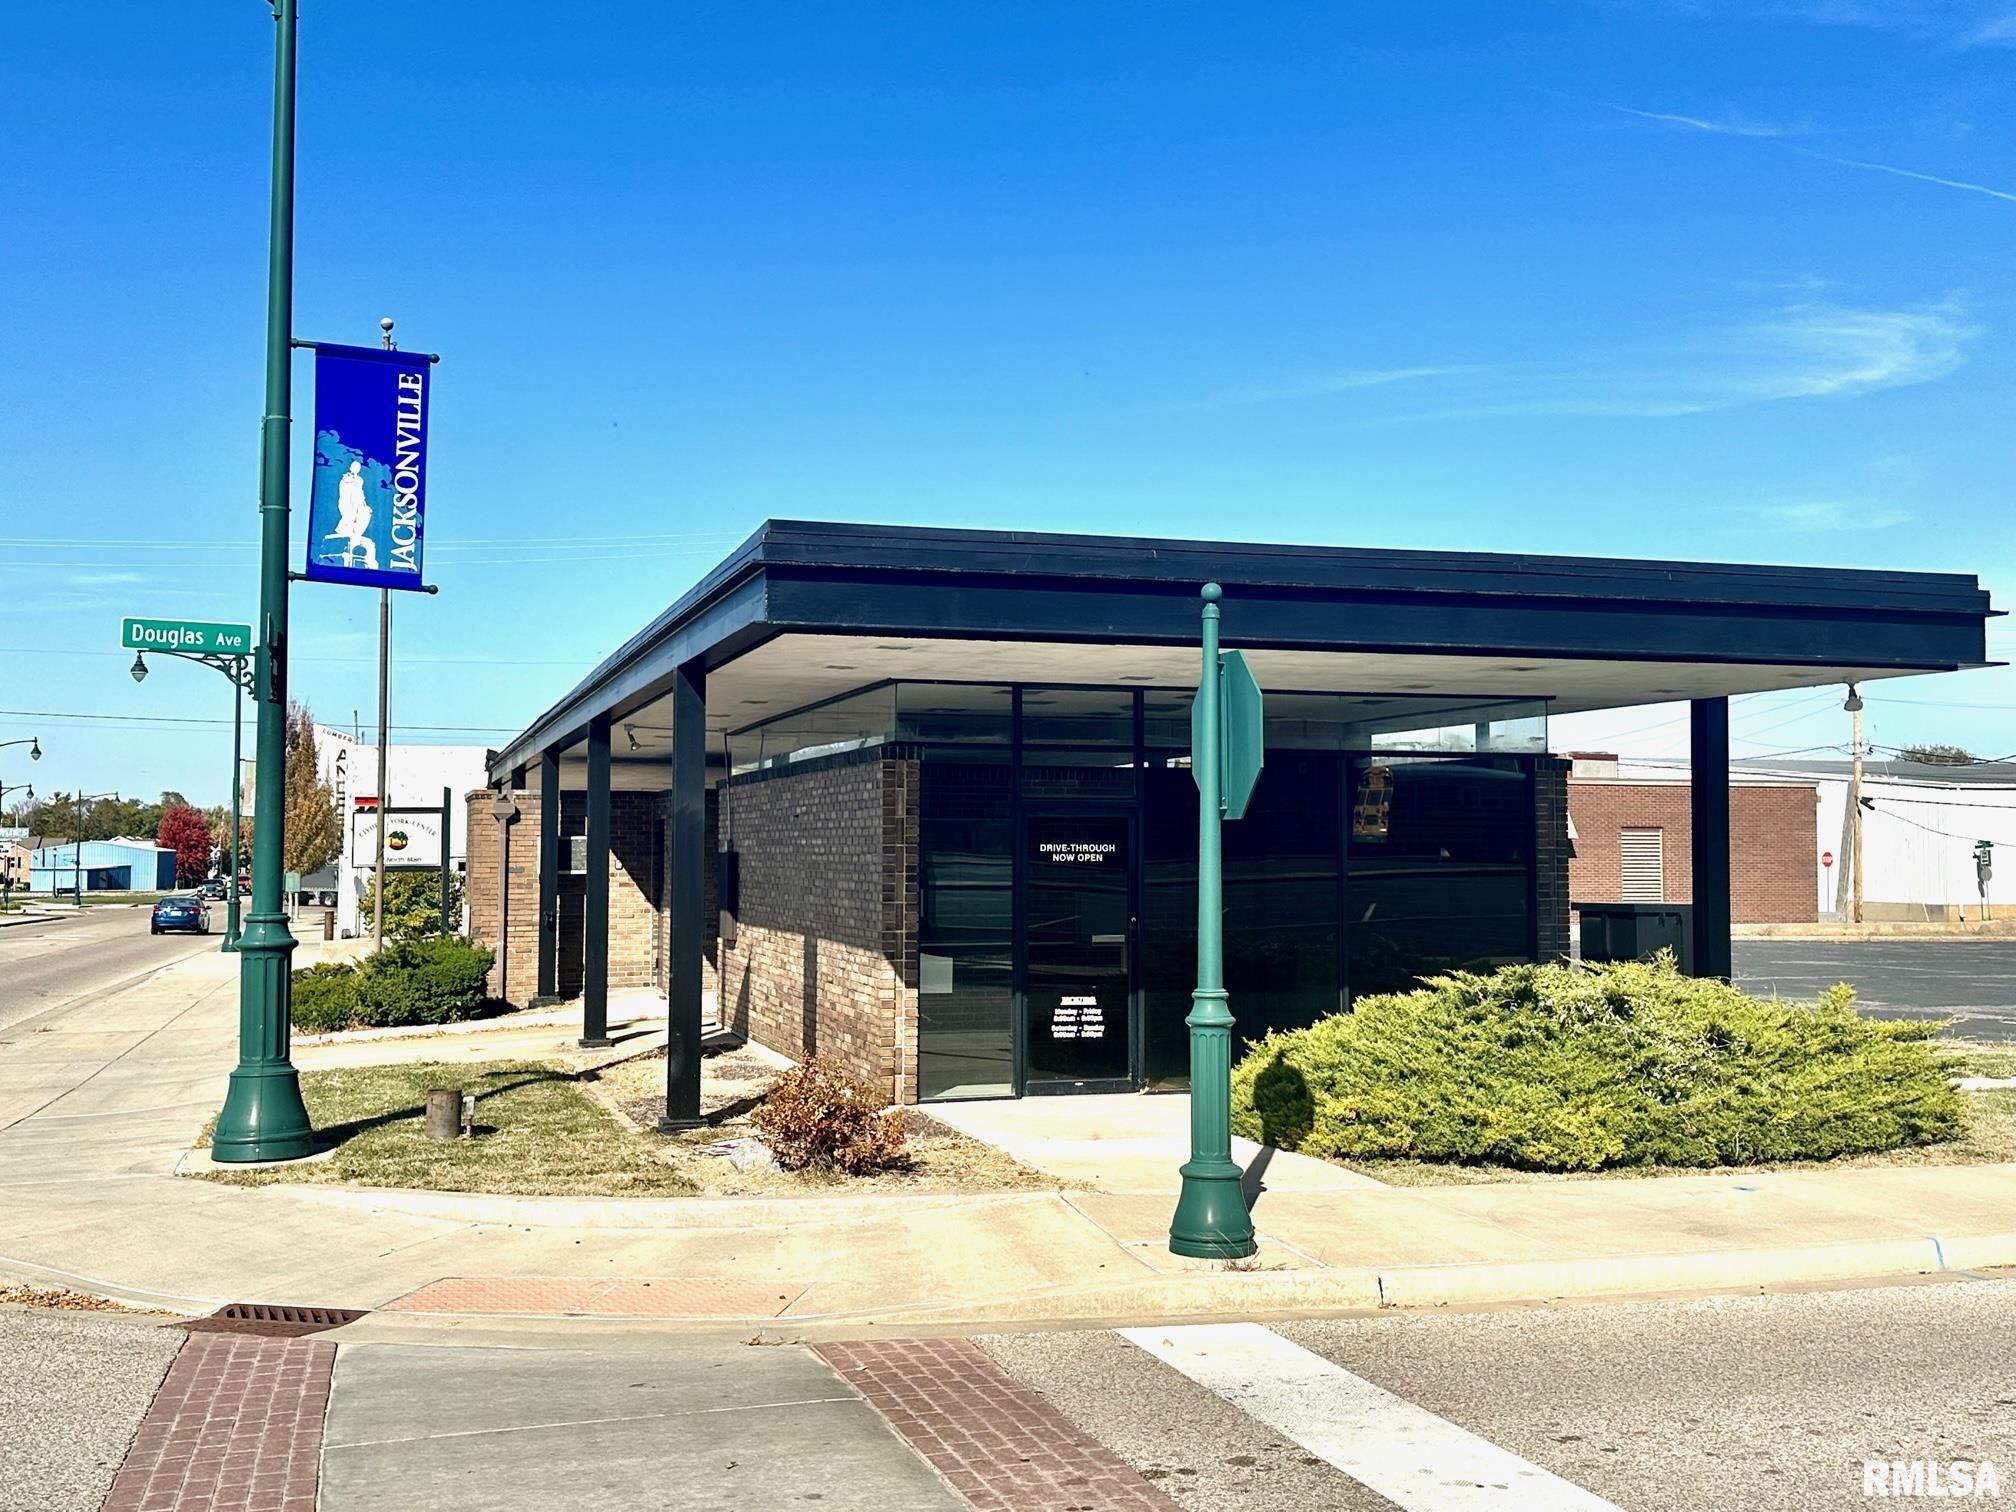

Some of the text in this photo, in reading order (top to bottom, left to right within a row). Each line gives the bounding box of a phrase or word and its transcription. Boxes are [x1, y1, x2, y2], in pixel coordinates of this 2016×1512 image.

[390, 373, 423, 572] JACKSONVILLE
[131, 624, 242, 649] Douglas Ave
[1040, 844, 1116, 852] DRIVE-THROUGH
[1052, 853, 1103, 862] NOW OPEN
